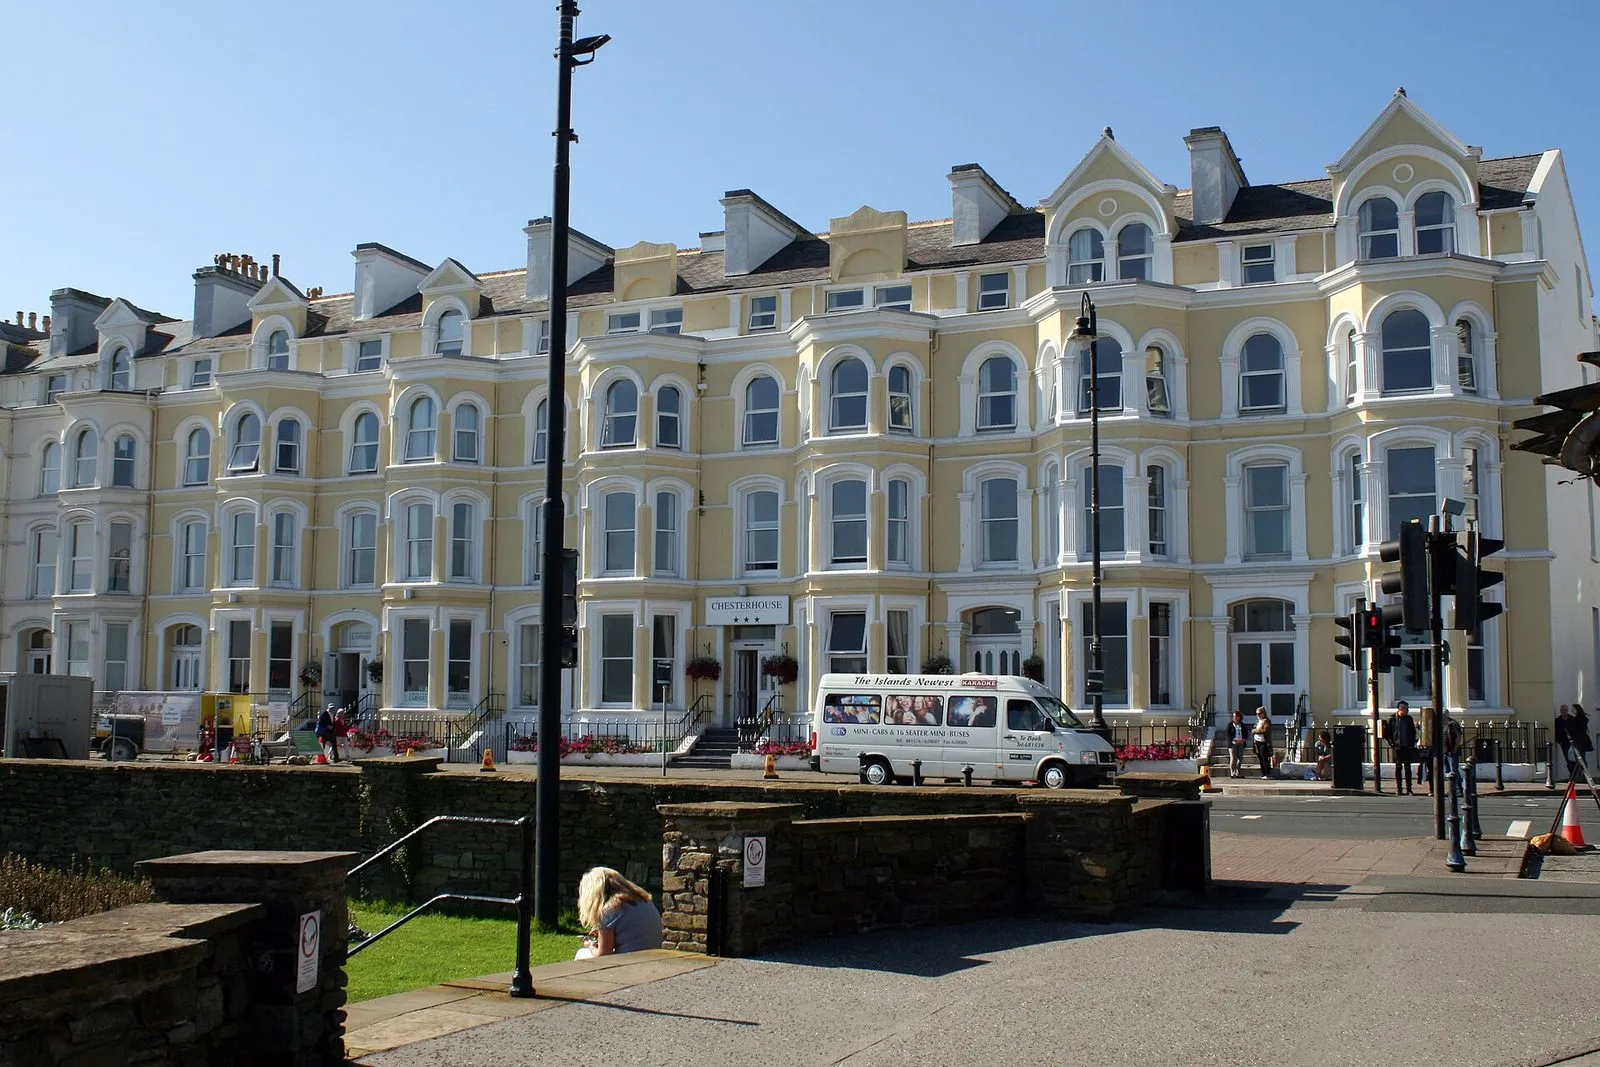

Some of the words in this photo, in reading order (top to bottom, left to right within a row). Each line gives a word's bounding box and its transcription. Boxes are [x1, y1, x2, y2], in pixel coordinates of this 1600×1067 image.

[711, 601, 782, 610] CHESTERHOUSE
[854, 677, 871, 685] The
[875, 677, 912, 686] Islands
[915, 677, 954, 687] Newest
[905, 729, 928, 737] SEATER
